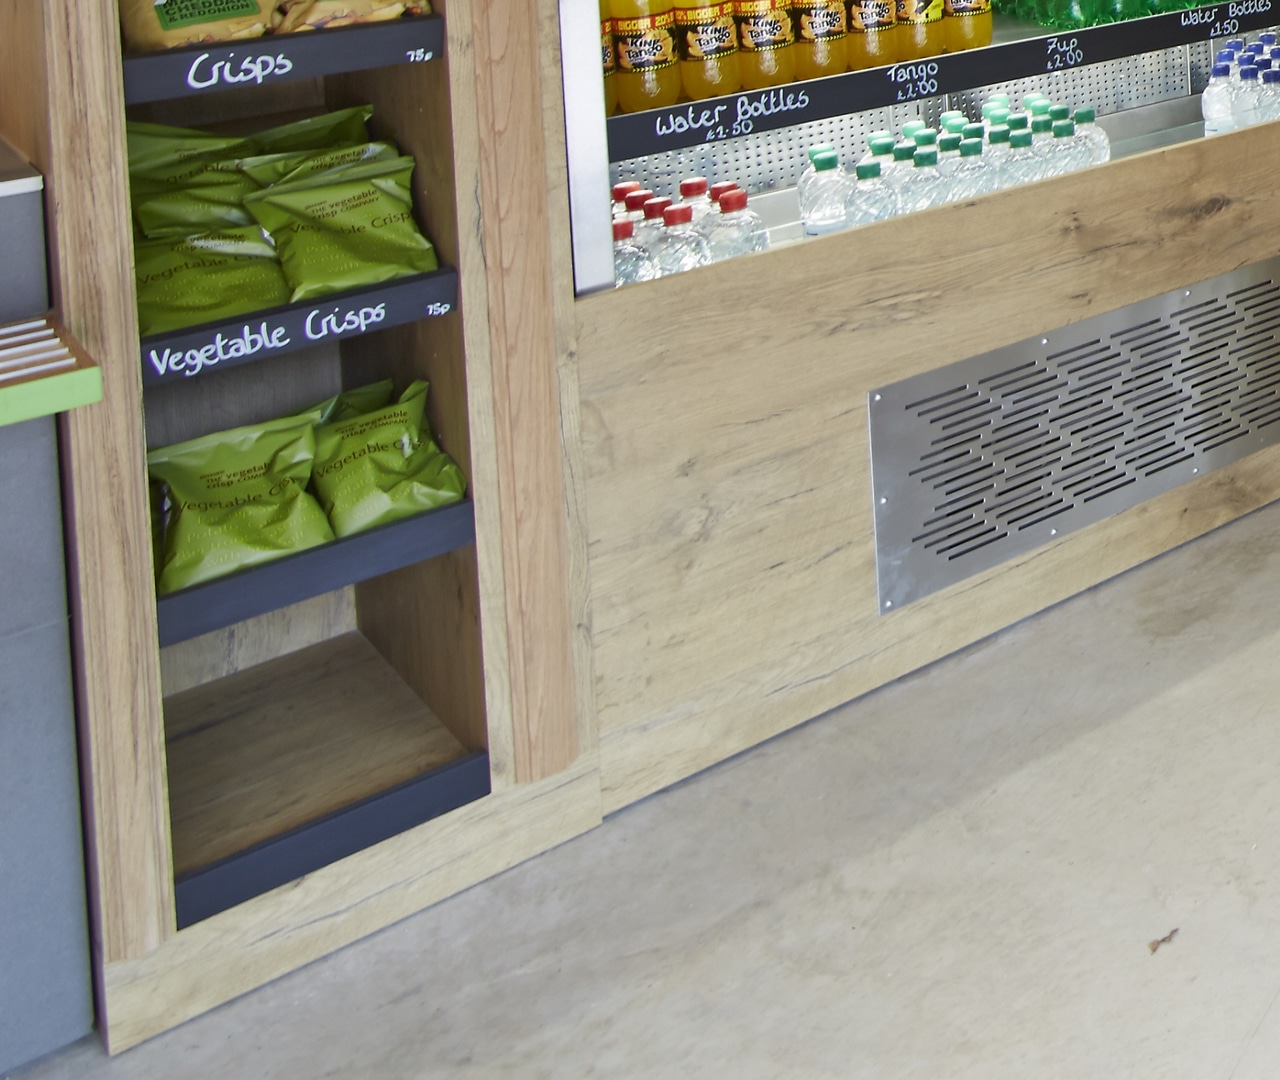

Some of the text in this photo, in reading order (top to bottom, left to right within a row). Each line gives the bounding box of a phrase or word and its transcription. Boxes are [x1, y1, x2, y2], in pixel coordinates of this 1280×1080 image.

[1180, 7, 1219, 27] Water
[695, 30, 731, 47] Tango
[625, 43, 664, 60] Tango
[186, 47, 434, 90] Crisps 75p
[885, 62, 939, 84] Tango
[654, 89, 811, 137] Water Bottles
[148, 299, 452, 378] Vegetable Crisps 75p
